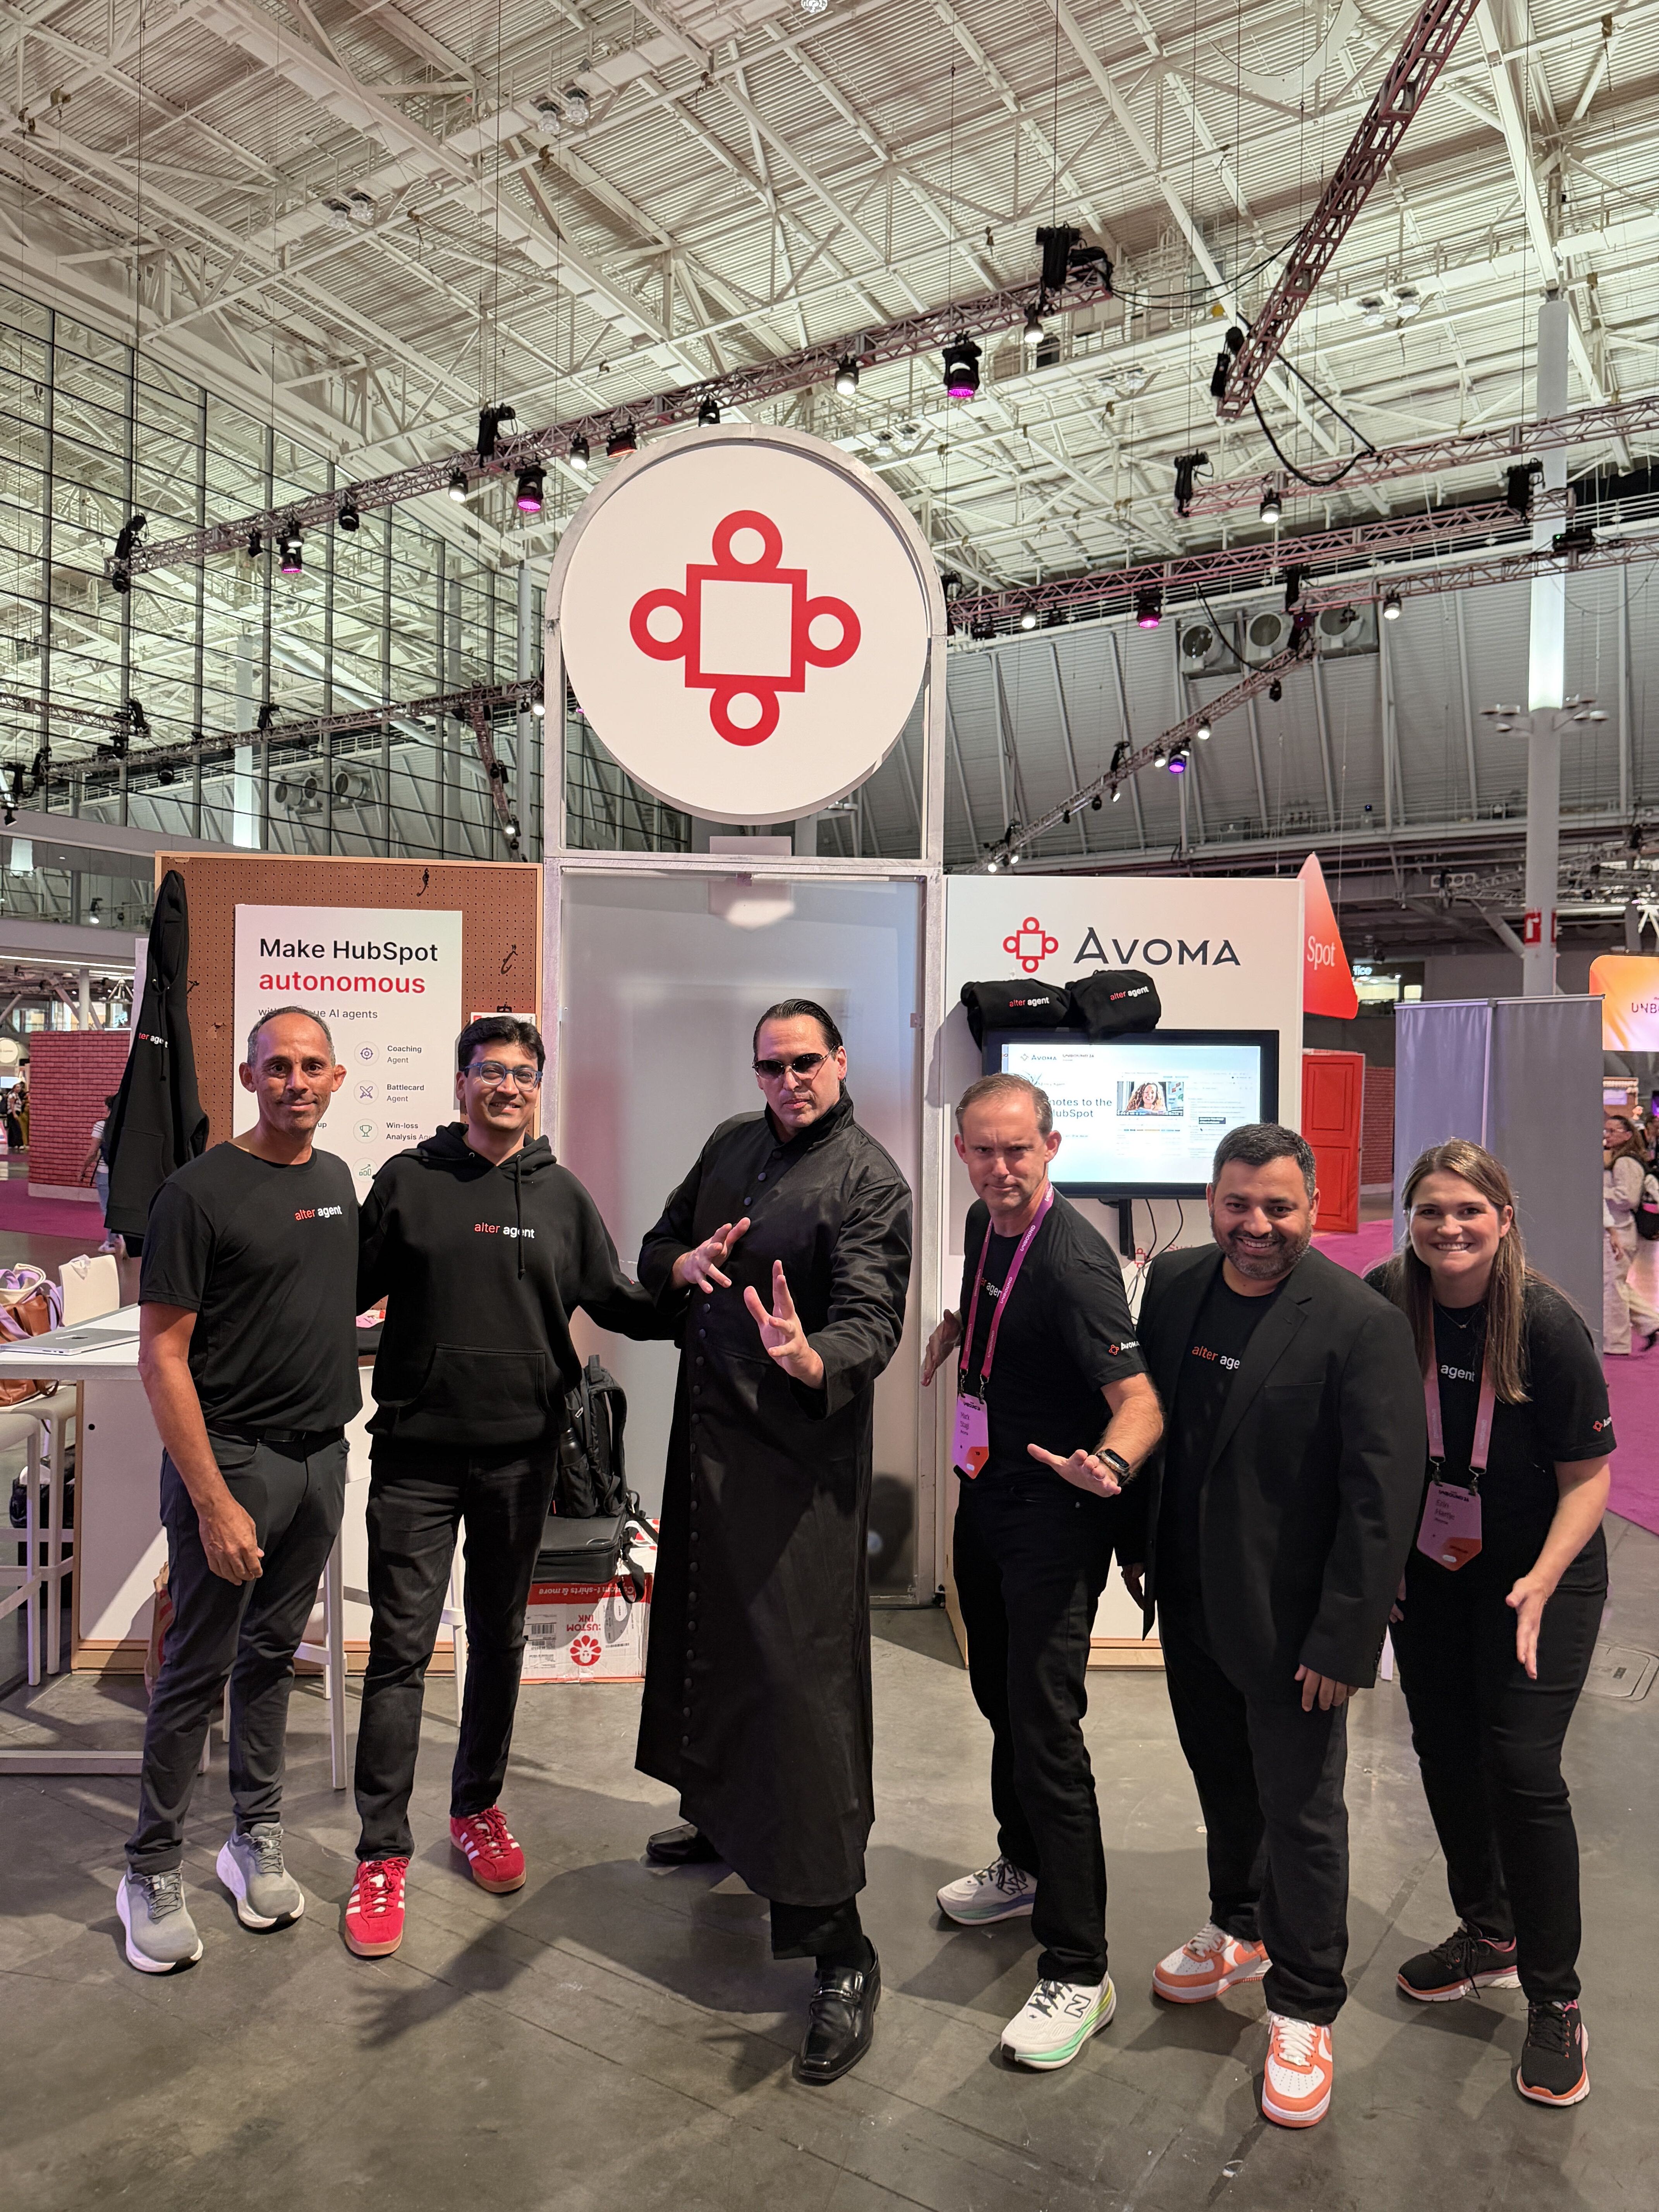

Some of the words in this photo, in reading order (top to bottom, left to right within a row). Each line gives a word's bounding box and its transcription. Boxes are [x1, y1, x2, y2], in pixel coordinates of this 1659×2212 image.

[260, 938, 325, 958] Make
[333, 940, 438, 965] HubSpot
[1307, 935, 1336, 970] Spot
[259, 971, 425, 993] autonomous
[1110, 991, 1126, 1000] alter
[1128, 986, 1149, 997] agent
[1027, 997, 1049, 1006] agent
[329, 1009, 339, 1017] AI
[342, 1010, 378, 1019] agents
[1632, 1003, 1659, 1013] UNB
[150, 1036, 168, 1048] aget
[387, 1045, 422, 1053] Coaching
[295, 1209, 315, 1221] alter
[318, 1205, 342, 1218] agent
[474, 1222, 500, 1233] alter
[1020, 1224, 1036, 1252] UNBOUND
[1000, 1276, 1013, 1304] UNBOUND
[1192, 1346, 1219, 1361] alter
[1220, 1355, 1240, 1370] age
[1441, 1365, 1475, 1382] agent
[562, 1587, 569, 1595] &
[570, 1587, 600, 1595] t-shirts
[578, 1614, 594, 1623] INK
[567, 1623, 601, 1632] USTOM
